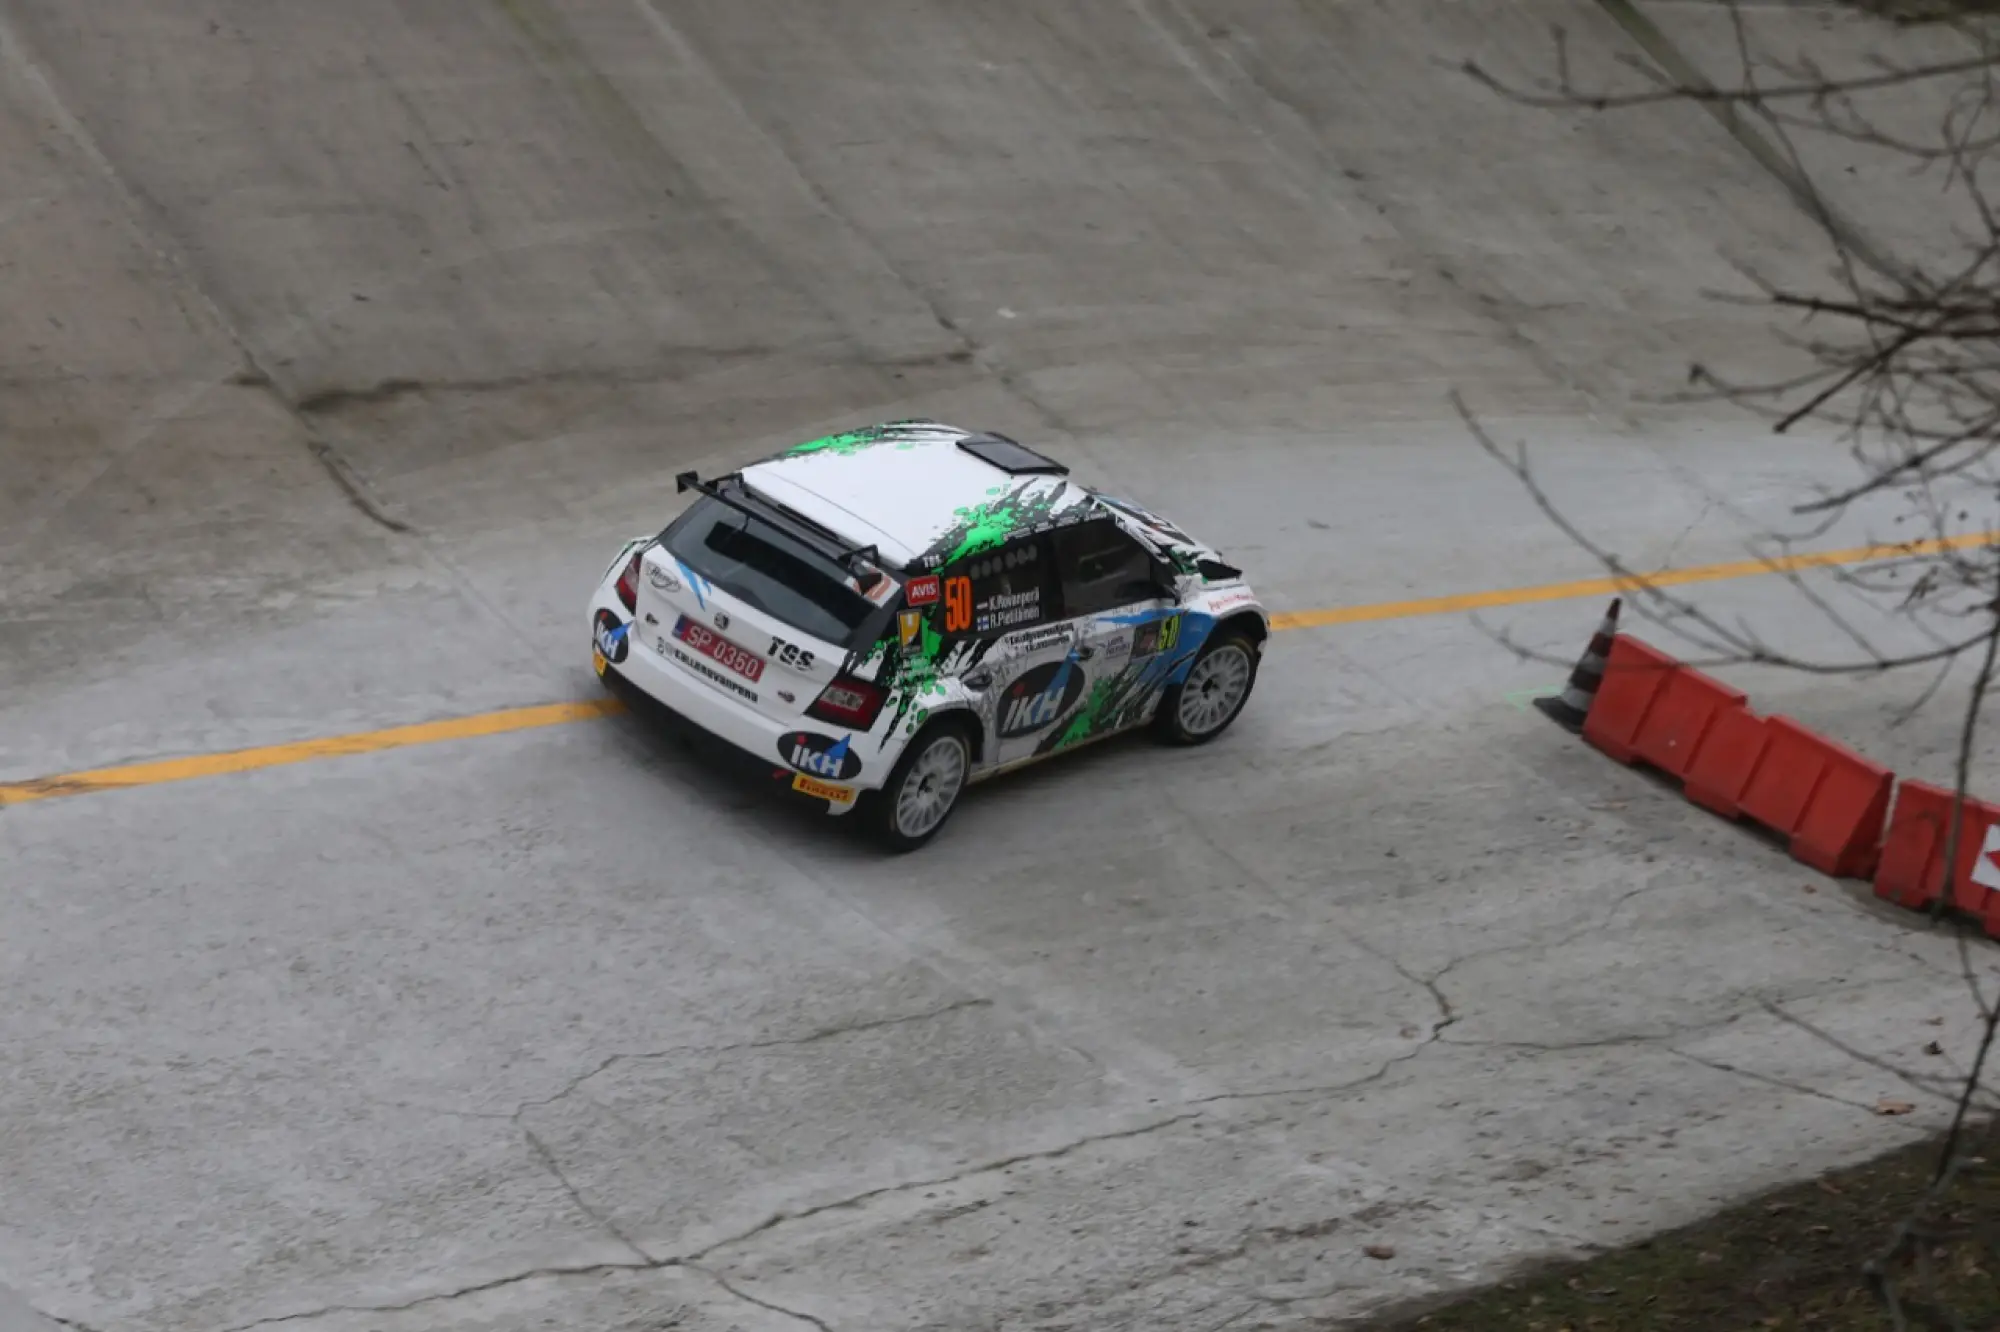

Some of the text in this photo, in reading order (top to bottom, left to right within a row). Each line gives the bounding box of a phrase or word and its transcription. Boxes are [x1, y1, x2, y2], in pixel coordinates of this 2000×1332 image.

[911, 583, 937, 598] AVIS
[945, 575, 972, 632] 50
[686, 625, 758, 677] SP 0350
[767, 635, 815, 672] TGS
